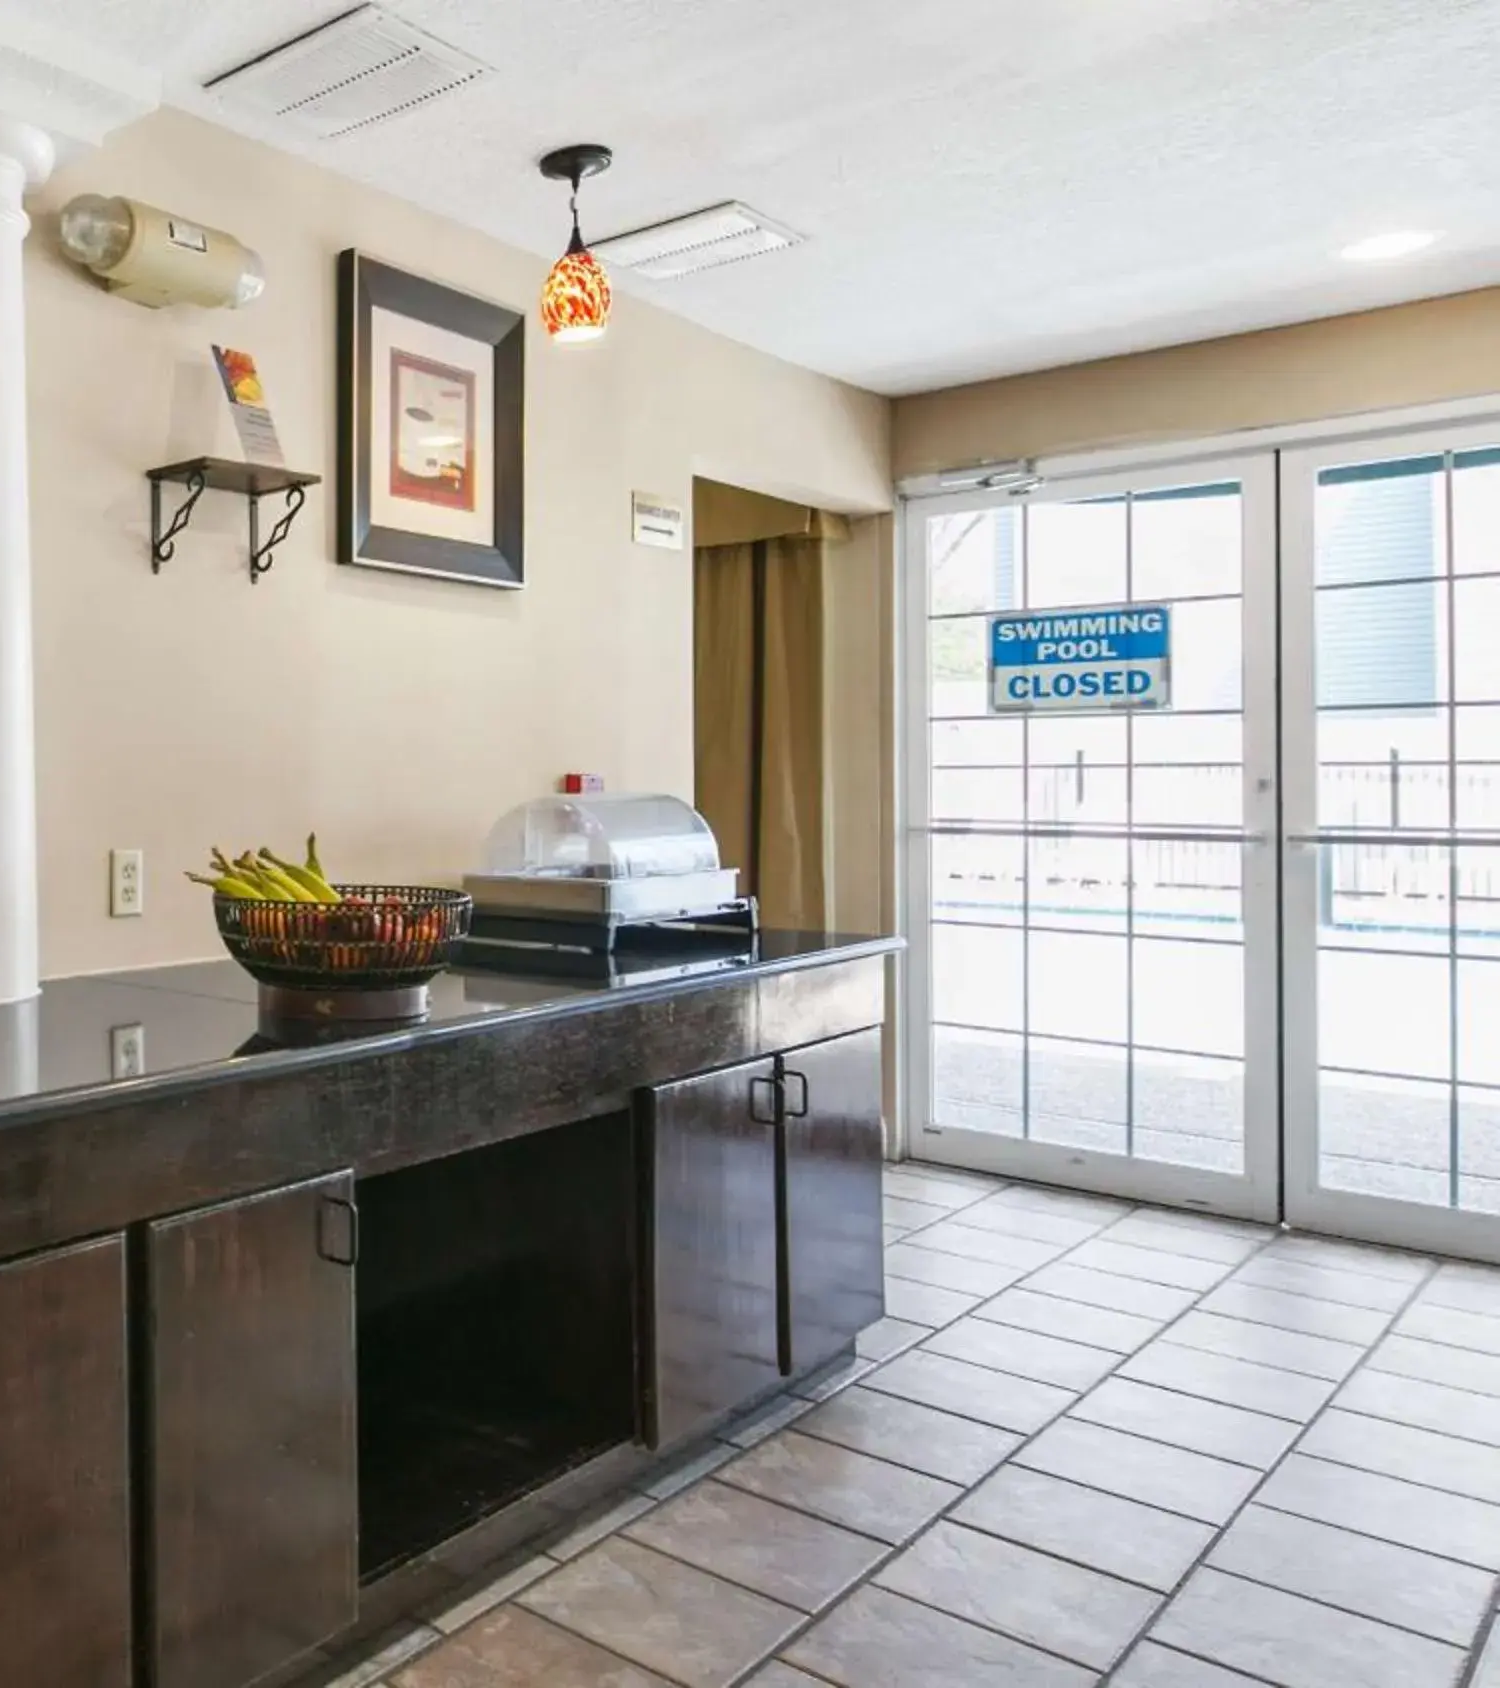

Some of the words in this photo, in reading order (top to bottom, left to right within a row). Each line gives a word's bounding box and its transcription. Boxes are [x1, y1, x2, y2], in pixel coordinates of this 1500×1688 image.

[997, 613, 1163, 641] SWIMMING
[1036, 639, 1118, 660] POOL
[1008, 669, 1152, 699] CLOSED
